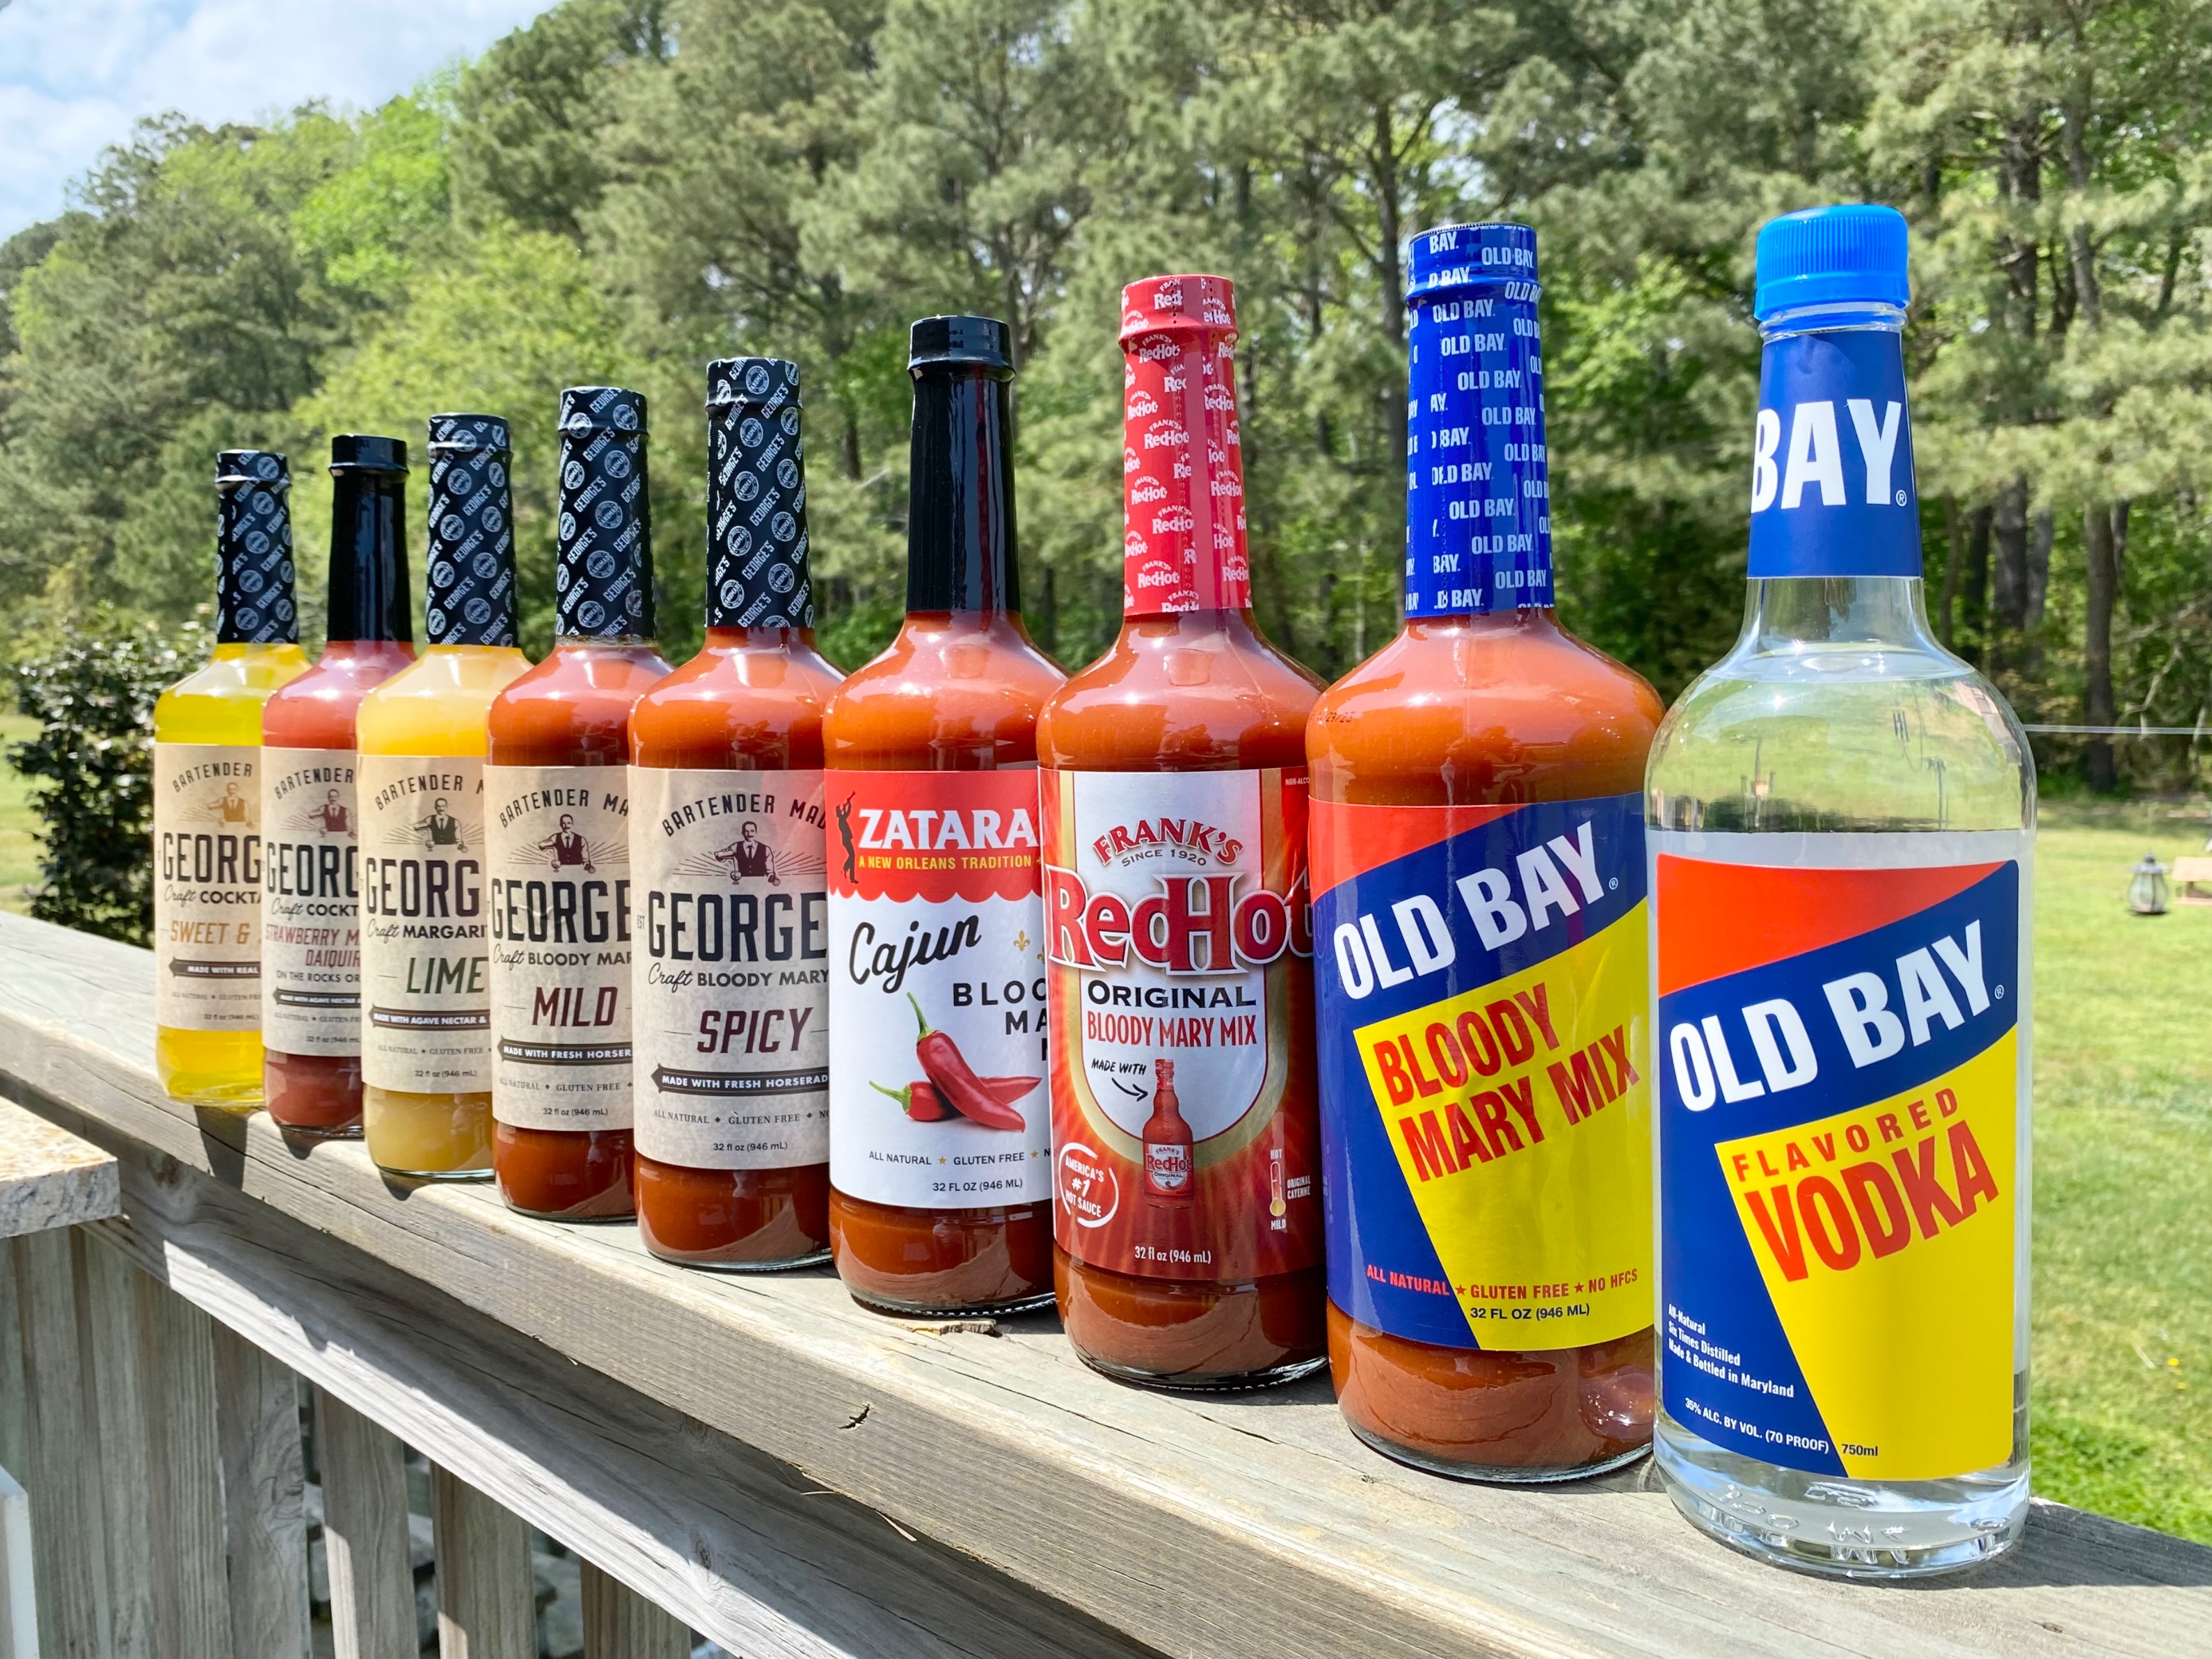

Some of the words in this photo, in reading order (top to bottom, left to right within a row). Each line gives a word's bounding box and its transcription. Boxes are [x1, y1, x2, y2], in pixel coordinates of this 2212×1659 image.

[1441, 336, 1470, 356] OLD
[1474, 333, 1504, 352] BAY
[1458, 371, 1490, 391] OLD
[1495, 370, 1521, 388] BAY
[1751, 399, 1902, 514] BAY
[749, 486, 781, 527] GEORGE'S
[1449, 500, 1479, 520] OLD
[1485, 498, 1514, 516] BAY
[1472, 535, 1503, 554] OLD
[1507, 534, 1532, 553] BAY
[1138, 571, 1180, 588] RedHot
[173, 763, 252, 793] BARTENDER
[274, 768, 353, 800] BARTENDER
[375, 775, 463, 811] BARTENDER
[499, 789, 589, 828] BARTENDER
[662, 794, 775, 836] BARTENDER
[859, 809, 1039, 850] ZATARA
[1092, 817, 1243, 866] FRANK'S
[164, 832, 261, 883] GEORG
[859, 857, 865, 868] A
[868, 857, 892, 869] NEW
[896, 857, 955, 870] ORLEANS
[962, 855, 1032, 869] TRADITION
[1122, 849, 1162, 867] SINCE
[1170, 848, 1207, 866] 1920
[164, 884, 196, 907] Craft
[367, 857, 479, 917] GEORG
[271, 898, 303, 921] Craft
[307, 904, 358, 916] COCKT
[492, 878, 630, 943] GEORGE
[1045, 864, 1313, 976] RedHot
[1334, 895, 1456, 999] OLD
[1456, 820, 1605, 951] BAY
[171, 921, 229, 944] SWEET
[266, 923, 340, 946] STRAWBERRY
[368, 919, 399, 944] Craft
[403, 925, 488, 939] MARGARI
[649, 891, 827, 962] GEORGE
[493, 944, 524, 971] Craft
[528, 953, 591, 966] BLOODY
[850, 915, 982, 994] Cajun
[289, 972, 303, 981] THE
[308, 974, 340, 983] ROCKS
[406, 957, 489, 994] LIME
[649, 962, 693, 993] Craft
[698, 973, 772, 987] BLOODY
[779, 969, 829, 985] MARY
[532, 986, 618, 1026] MILD
[1088, 980, 1256, 1008] ORIGINAL
[1088, 1011, 1154, 1046] BLOODY
[1159, 1017, 1214, 1047] MARY
[1220, 1015, 1257, 1045] MIX
[1670, 999, 1817, 1111] OLD
[1822, 919, 1990, 1068] BAY
[697, 1007, 814, 1054] SPICY
[1373, 982, 1560, 1106] BLOODY
[504, 1047, 523, 1056] MADE
[525, 1049, 548, 1058] WITH
[551, 1050, 582, 1058] FRESH
[1091, 1058, 1116, 1073] MADE
[1120, 1062, 1147, 1075] WITH
[662, 1075, 687, 1086] MADE
[692, 1079, 719, 1088] WITH
[725, 1080, 761, 1088] FRESH
[1399, 1075, 1545, 1182] MARY
[1547, 1024, 1640, 1126] MIX
[653, 1110, 666, 1118] ALL
[668, 1112, 709, 1124] NATURAL
[729, 1116, 770, 1125] GLUTEN
[774, 1113, 800, 1122] FREE
[747, 1143, 767, 1152] (946
[771, 1142, 788, 1150] mL)
[1732, 1088, 1958, 1182] FLAVORED
[869, 1150, 884, 1161] ALL
[886, 1153, 932, 1165] NATURAL
[953, 1155, 995, 1166] GLUTEN
[999, 1152, 1025, 1162] FREE
[1145, 1153, 1191, 1172] RedHot
[1271, 1149, 1282, 1159] HOT
[1065, 1155, 1104, 1182] AMERICA'S
[1287, 1175, 1310, 1189] ORIGINAL
[932, 1183, 946, 1191] 32
[949, 1183, 960, 1191] FL
[963, 1183, 977, 1191] OZ
[980, 1181, 1003, 1193] (946
[1006, 1179, 1022, 1189] ML)
[1072, 1177, 1090, 1197] #1
[1287, 1186, 1310, 1199] CAYENNE
[1065, 1189, 1076, 1205] HOT
[1078, 1197, 1101, 1217] SAUCE
[1744, 1120, 1999, 1282] VODKA
[1271, 1219, 1286, 1230] MILD
[1135, 1246, 1146, 1259] 32
[1157, 1251, 1168, 1261] oz
[1170, 1250, 1191, 1263] (946
[1193, 1250, 1211, 1264] mL)
[1367, 1264, 1386, 1283] ALL
[1390, 1271, 1450, 1296] NATURAL
[1470, 1284, 1527, 1299] GLUTEN
[1533, 1283, 1568, 1299] FREE
[1589, 1277, 1605, 1293] NO
[1610, 1269, 1638, 1288] HFCS
[1470, 1308, 1486, 1319] 32
[1490, 1308, 1507, 1319] FL
[1511, 1308, 1531, 1319] OZ
[1536, 1305, 1563, 1321] (946
[1566, 1303, 1590, 1317] ML)
[1669, 1303, 1705, 1335] All-Natural
[1669, 1321, 1677, 1336] Six
[1678, 1328, 1699, 1349] Times
[1701, 1340, 1740, 1366] Distilled
[1669, 1337, 1685, 1359] Made
[1686, 1351, 1691, 1363] &
[1694, 1354, 1725, 1379] Bottled
[1728, 1370, 1737, 1383] in
[1742, 1374, 1794, 1398] Maryland
[1685, 1397, 1701, 1415] 35%
[1703, 1407, 1721, 1424] ALC.
[1724, 1416, 1737, 1430] BY
[1740, 1422, 1763, 1438] VOL.
[1765, 1429, 1783, 1443] (70
[1786, 1436, 1829, 1454] PROOF)
[1842, 1443, 1878, 1456] 750ml
